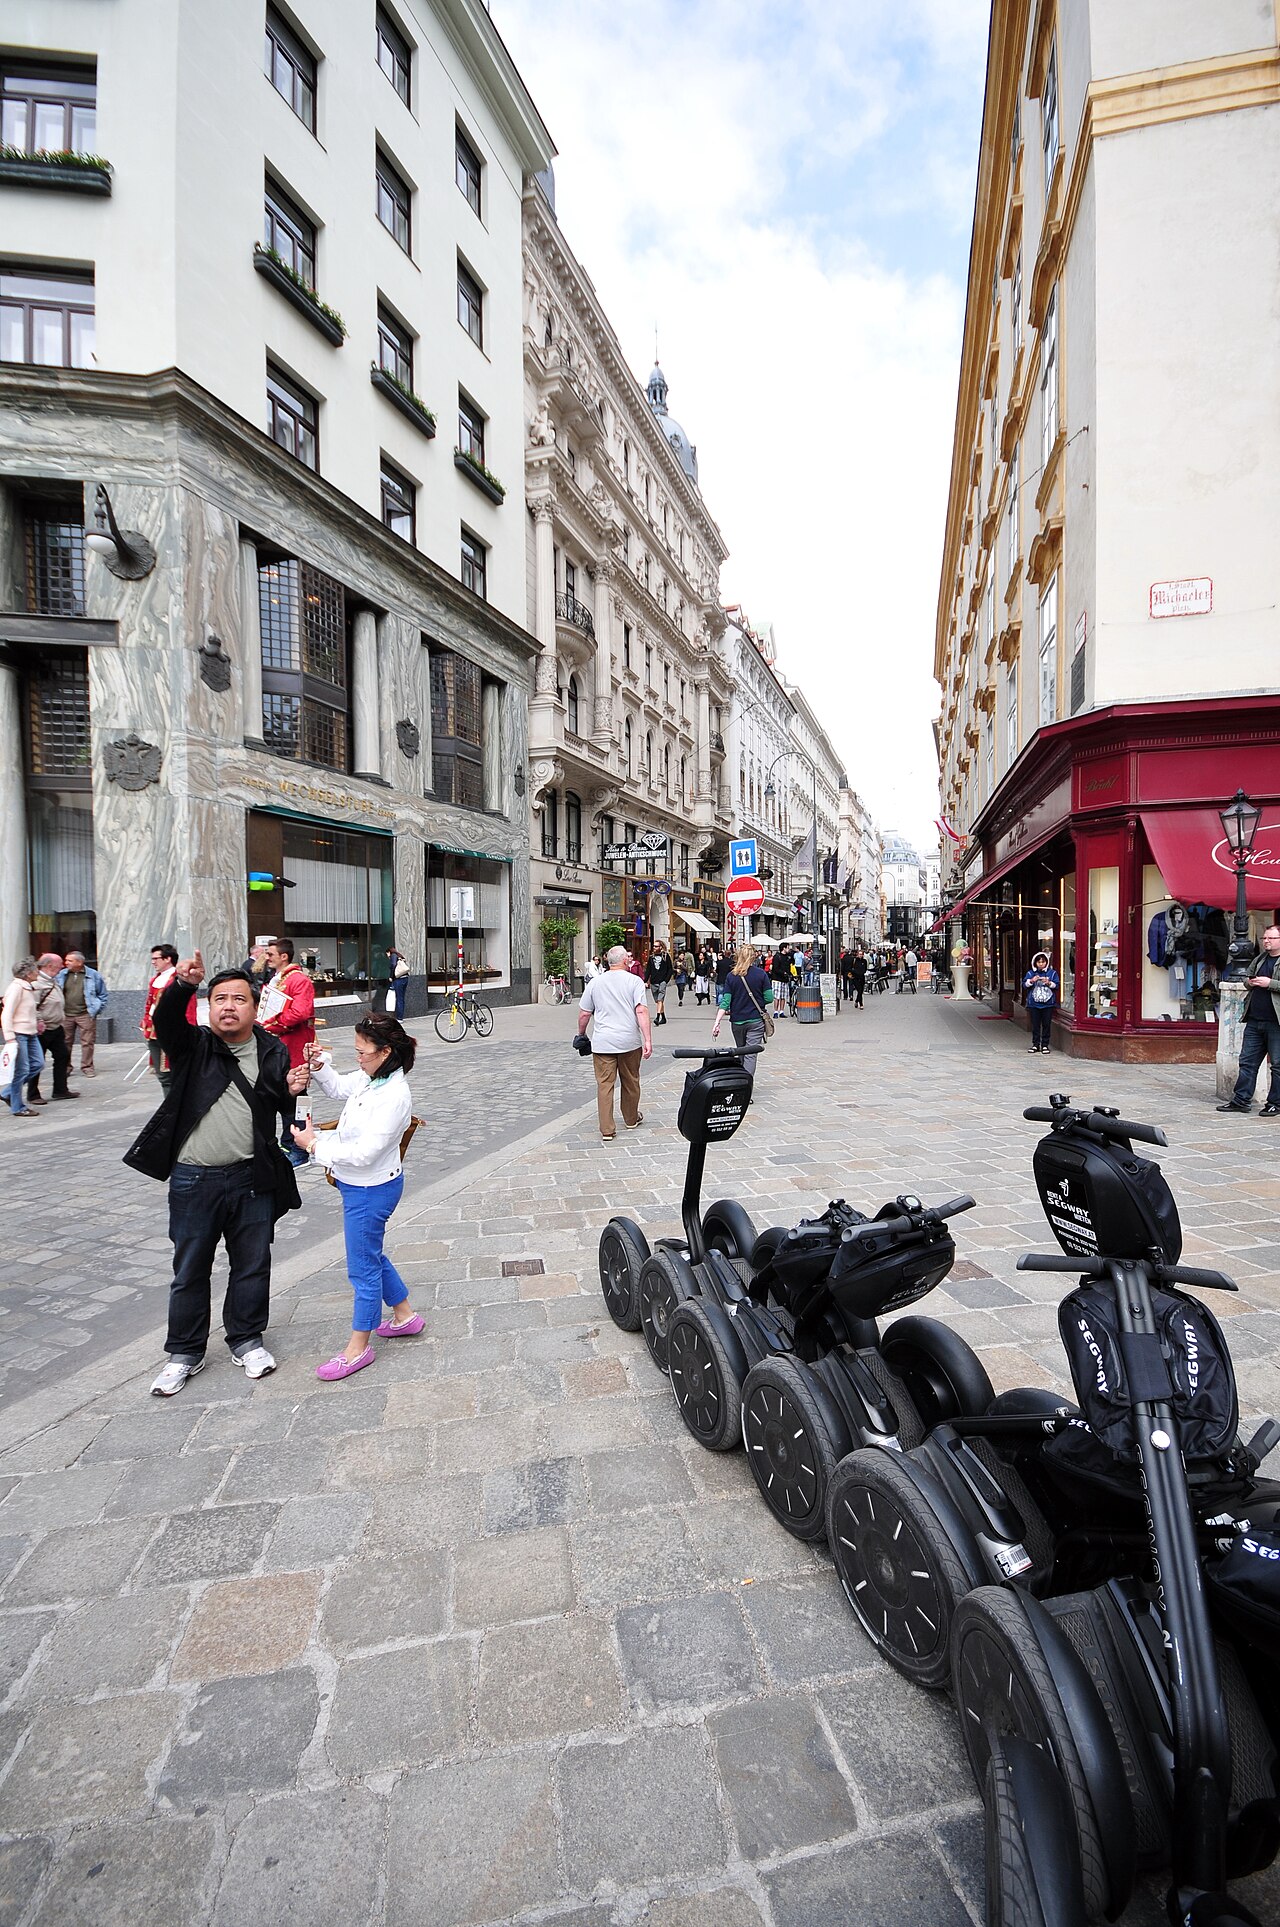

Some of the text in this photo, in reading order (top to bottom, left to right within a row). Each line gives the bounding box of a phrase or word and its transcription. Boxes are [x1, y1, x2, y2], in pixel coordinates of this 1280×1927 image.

[278, 779, 374, 815] WECHSELSTUBE
[727, 911, 737, 941] ANZ
[1047, 1197, 1089, 1217] SEGWAY
[1078, 1319, 1109, 1393] SEGWAY
